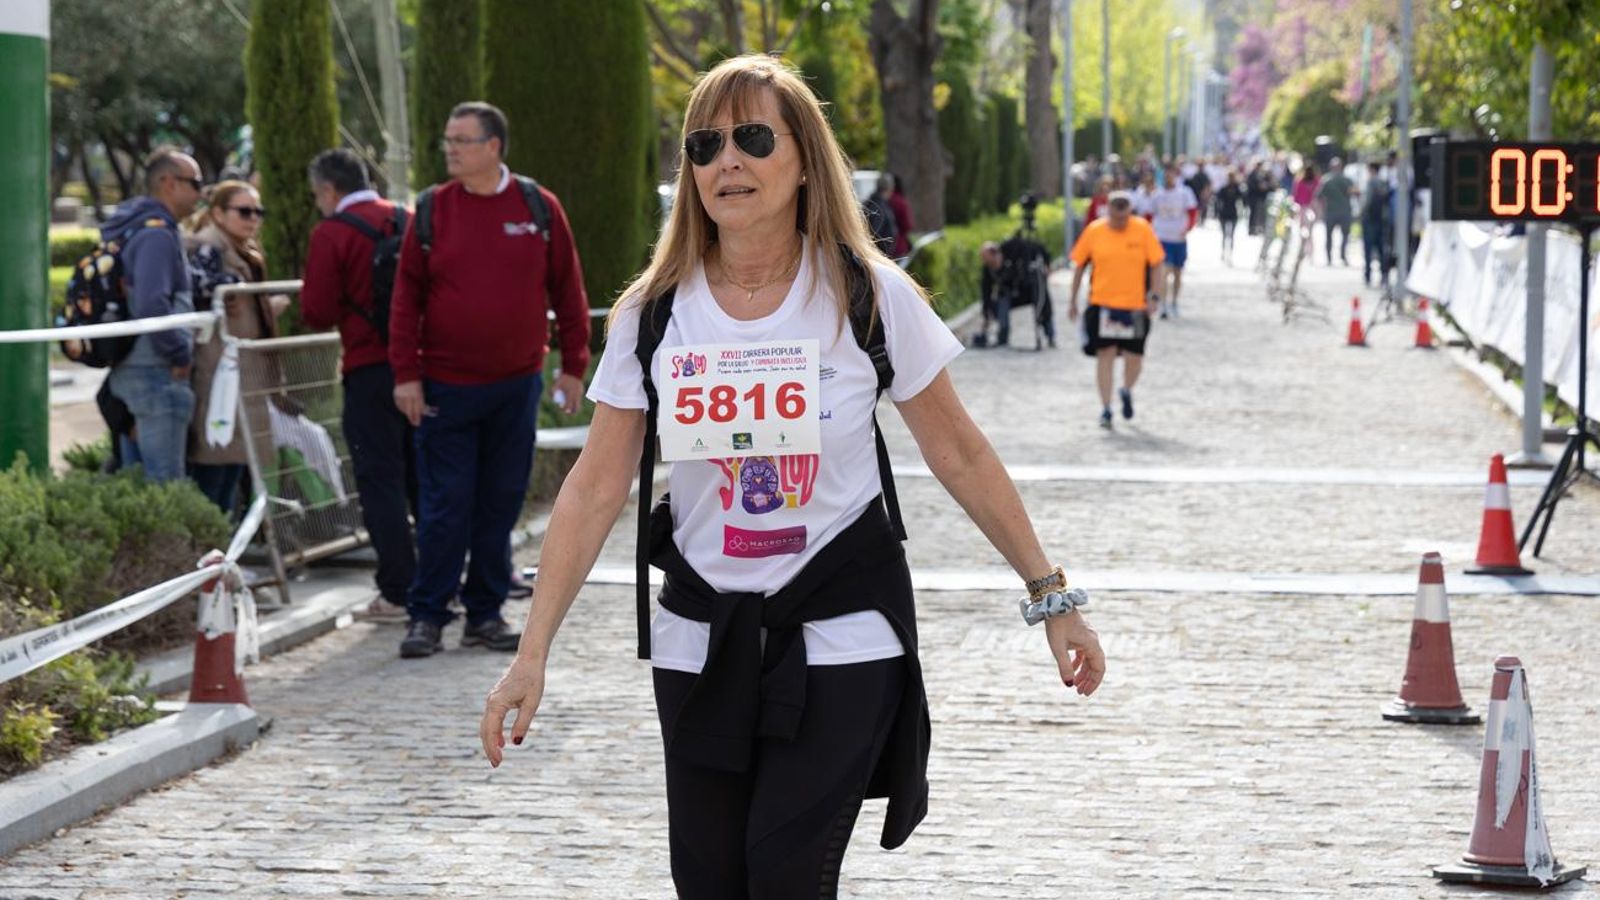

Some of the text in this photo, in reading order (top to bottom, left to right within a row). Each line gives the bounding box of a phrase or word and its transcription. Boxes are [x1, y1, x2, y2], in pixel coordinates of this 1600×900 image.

[1490, 148, 1600, 216] 00:
[720, 346, 802, 360] XXVII CARRERA POPULAR
[674, 381, 807, 425] 5816
